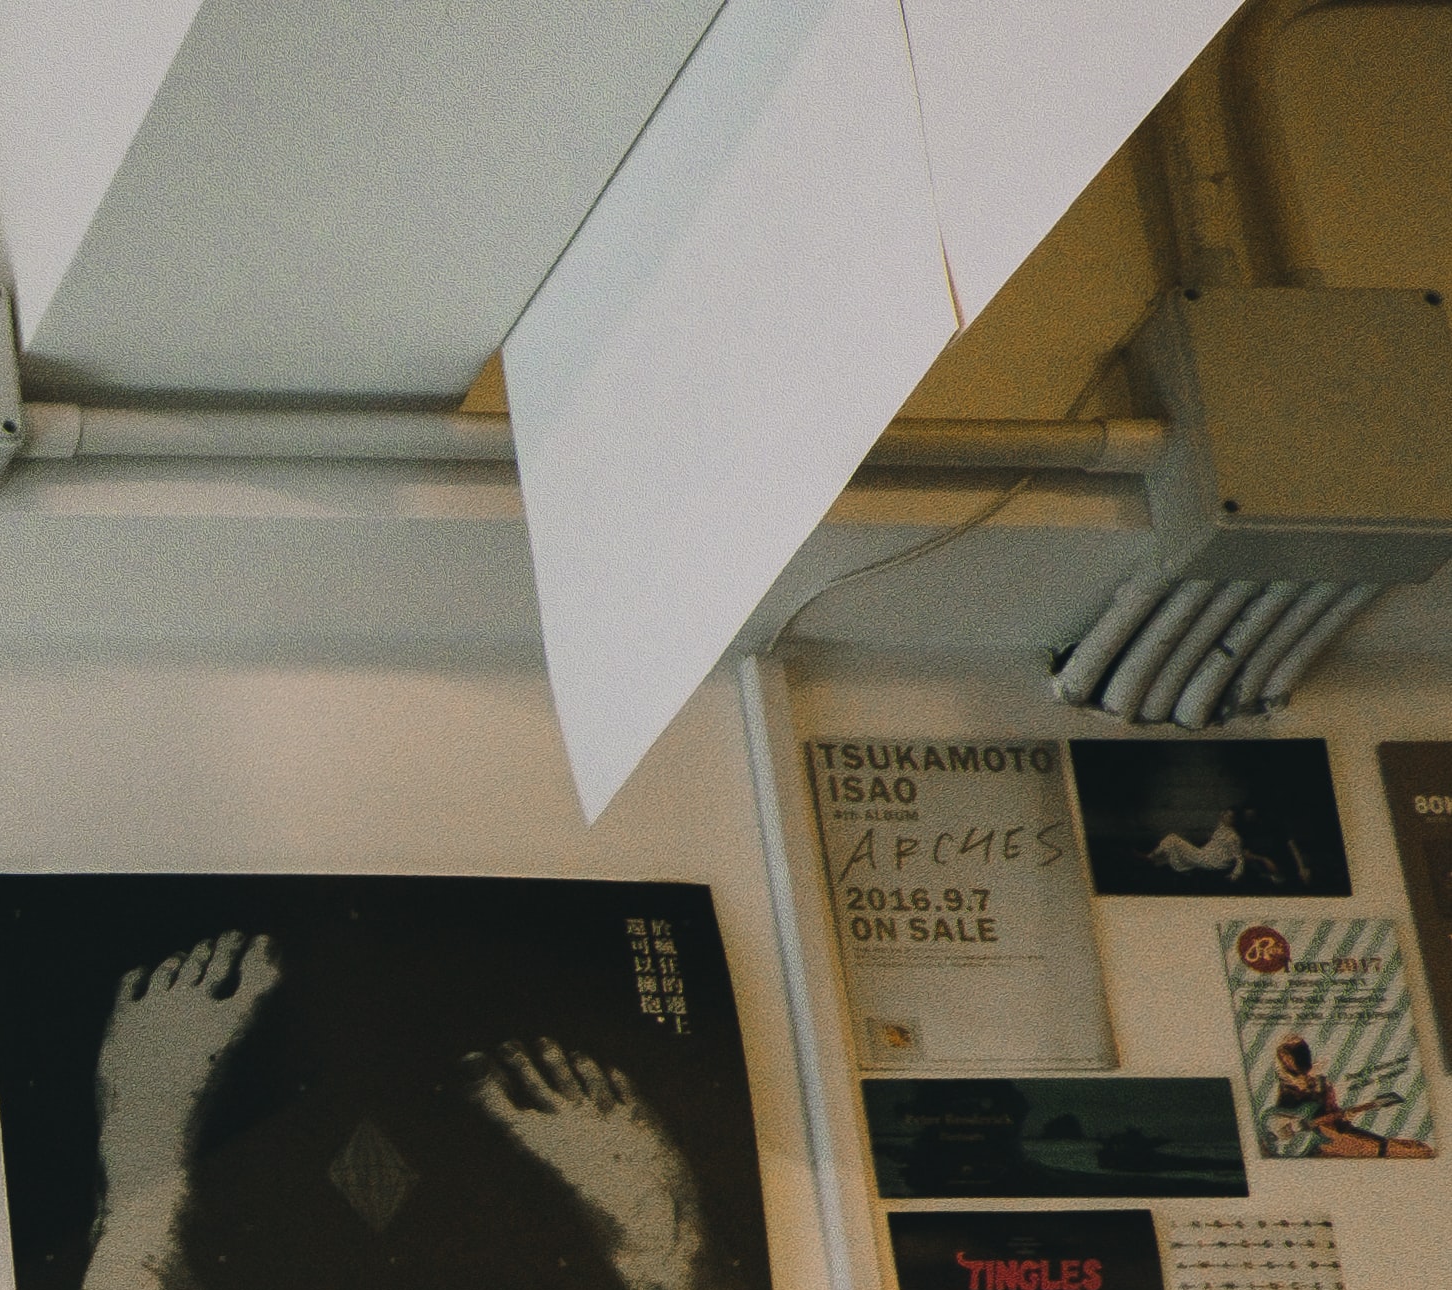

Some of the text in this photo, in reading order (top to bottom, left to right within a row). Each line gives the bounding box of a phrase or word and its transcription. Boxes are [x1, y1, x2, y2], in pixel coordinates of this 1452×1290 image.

[816, 743, 1057, 774] TSUKAMOTO
[827, 775, 919, 804] ISAO
[845, 886, 992, 913] 2016.9.7
[850, 917, 1000, 943] ON SALE
